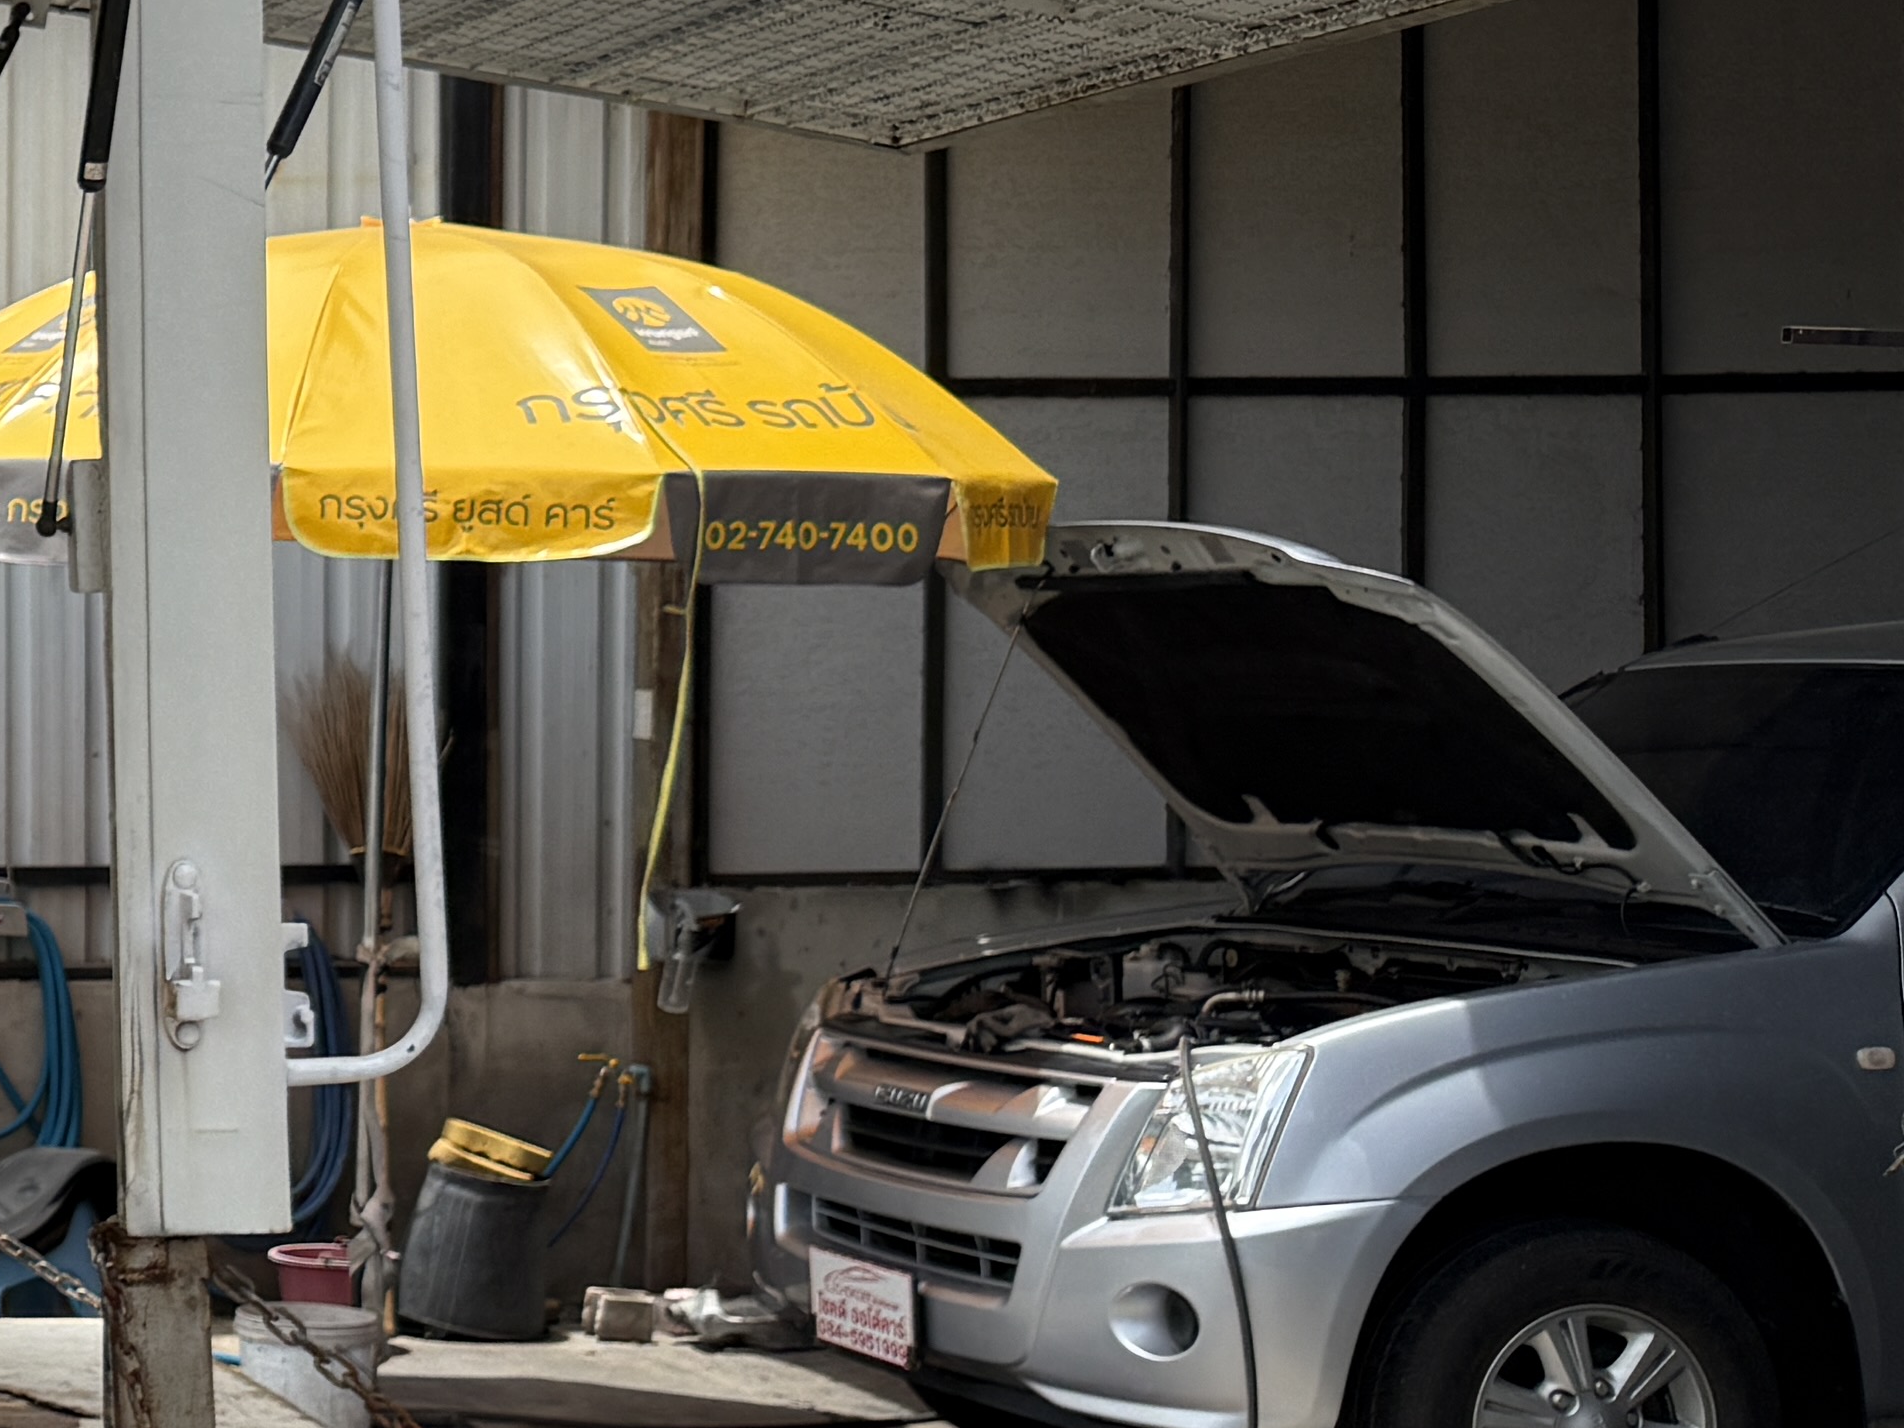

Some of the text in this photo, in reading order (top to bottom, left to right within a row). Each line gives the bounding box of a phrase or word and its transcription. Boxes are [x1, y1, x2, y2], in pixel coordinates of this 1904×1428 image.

[318, 487, 439, 530] กรุงรี
[544, 496, 617, 532] คาร์
[704, 519, 919, 554] 02-740-7400
